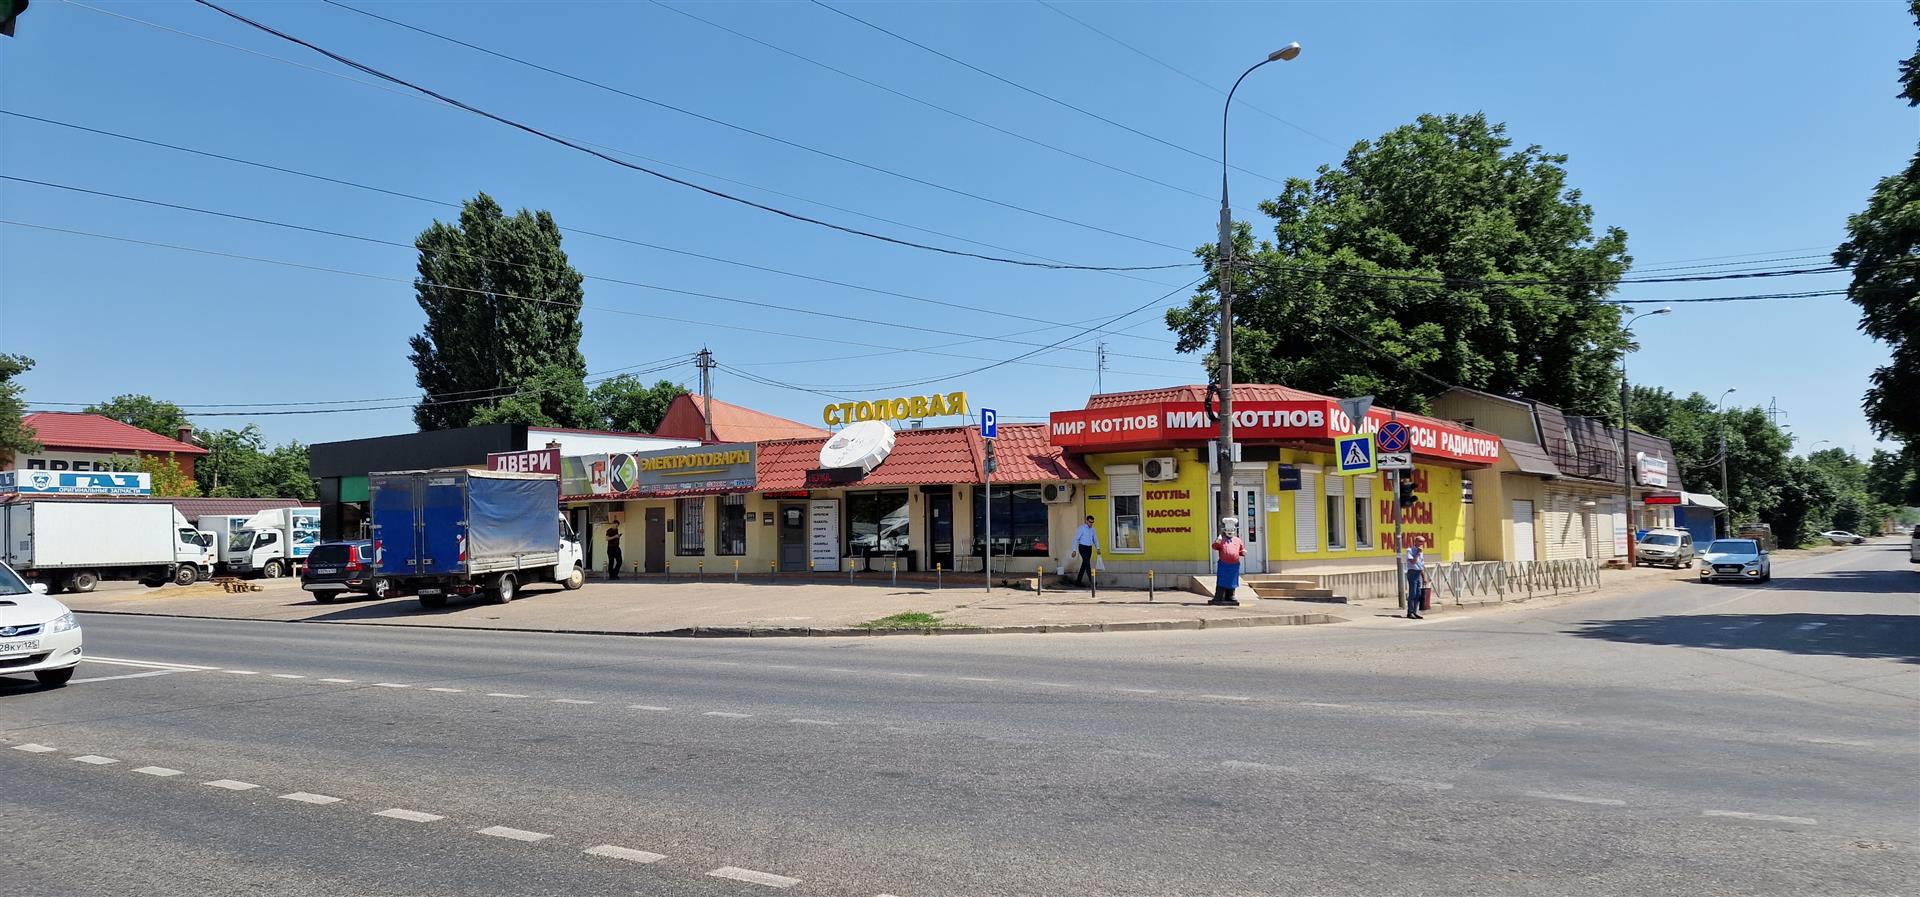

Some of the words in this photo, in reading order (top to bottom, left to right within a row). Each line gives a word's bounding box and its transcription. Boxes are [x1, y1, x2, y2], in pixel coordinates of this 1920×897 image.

[823, 391, 967, 426] СТОЛОВАЯ
[1052, 421, 1086, 436] МИР
[1091, 415, 1158, 433] КОТЛОВ
[1441, 431, 1499, 457] РАДИАТОРЫ
[496, 452, 551, 472] ДВЕРИ
[640, 450, 750, 471] ЭЛЕКТРОТОВАРЫ
[1146, 489, 1190, 500] КОТЛЫ
[1147, 509, 1191, 518] НАСОСЫ
